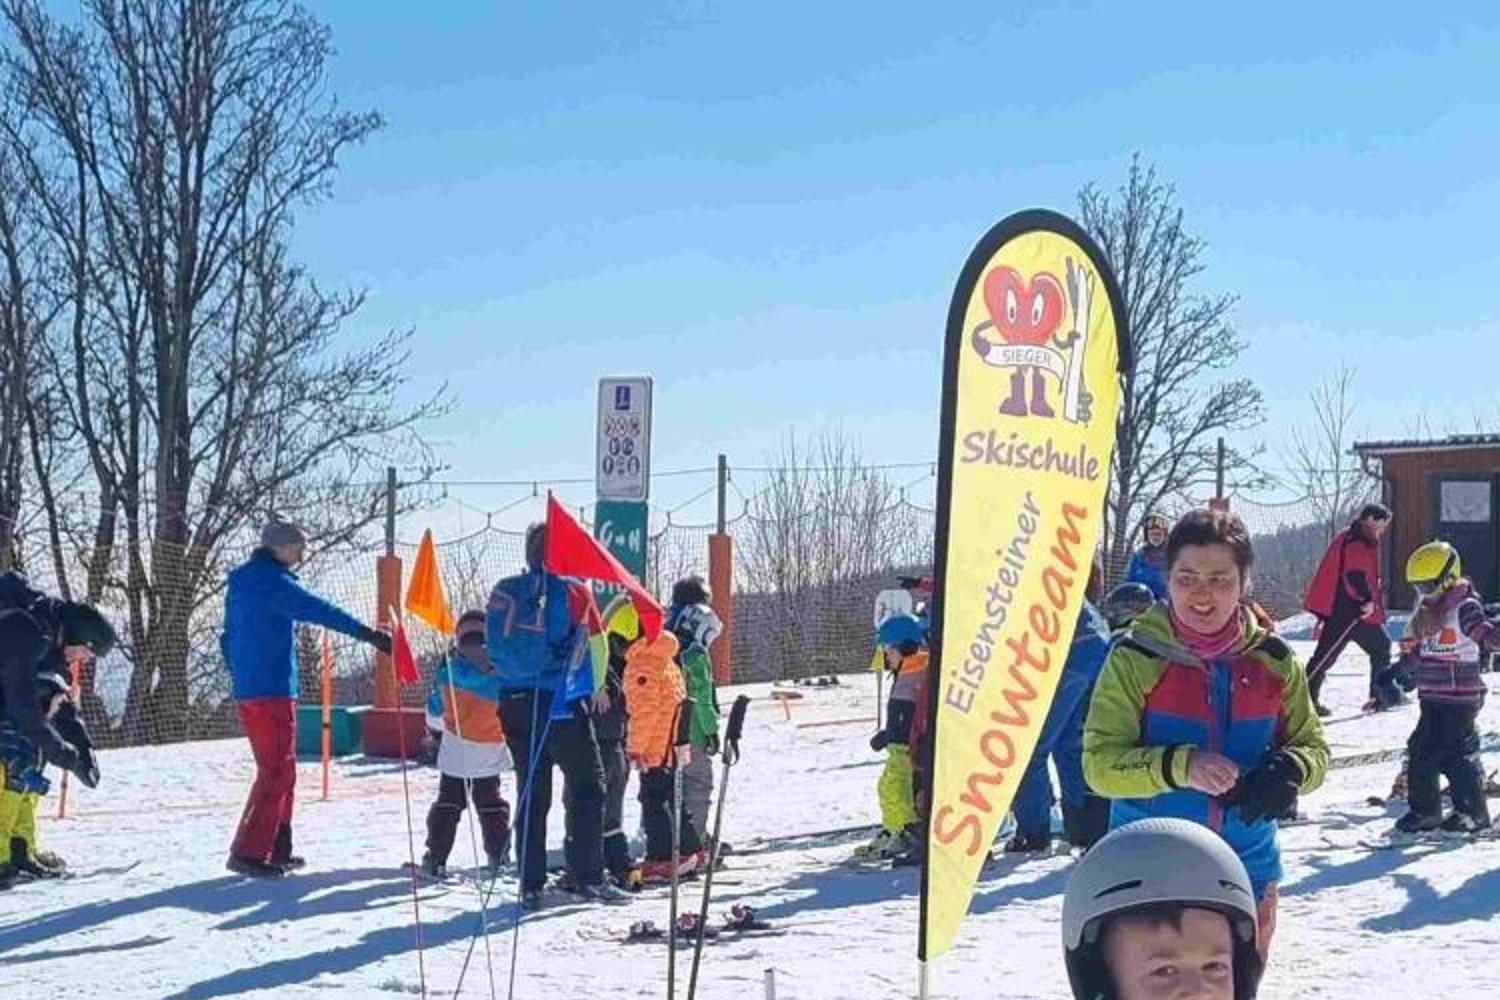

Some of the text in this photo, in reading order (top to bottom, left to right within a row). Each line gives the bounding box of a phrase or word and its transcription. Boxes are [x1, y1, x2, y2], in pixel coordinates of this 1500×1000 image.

[1002, 350, 1053, 365] SIEGER
[961, 429, 1099, 481] Skischule
[946, 490, 1042, 716] Eisensteiner
[934, 501, 1088, 857] Snowteam
